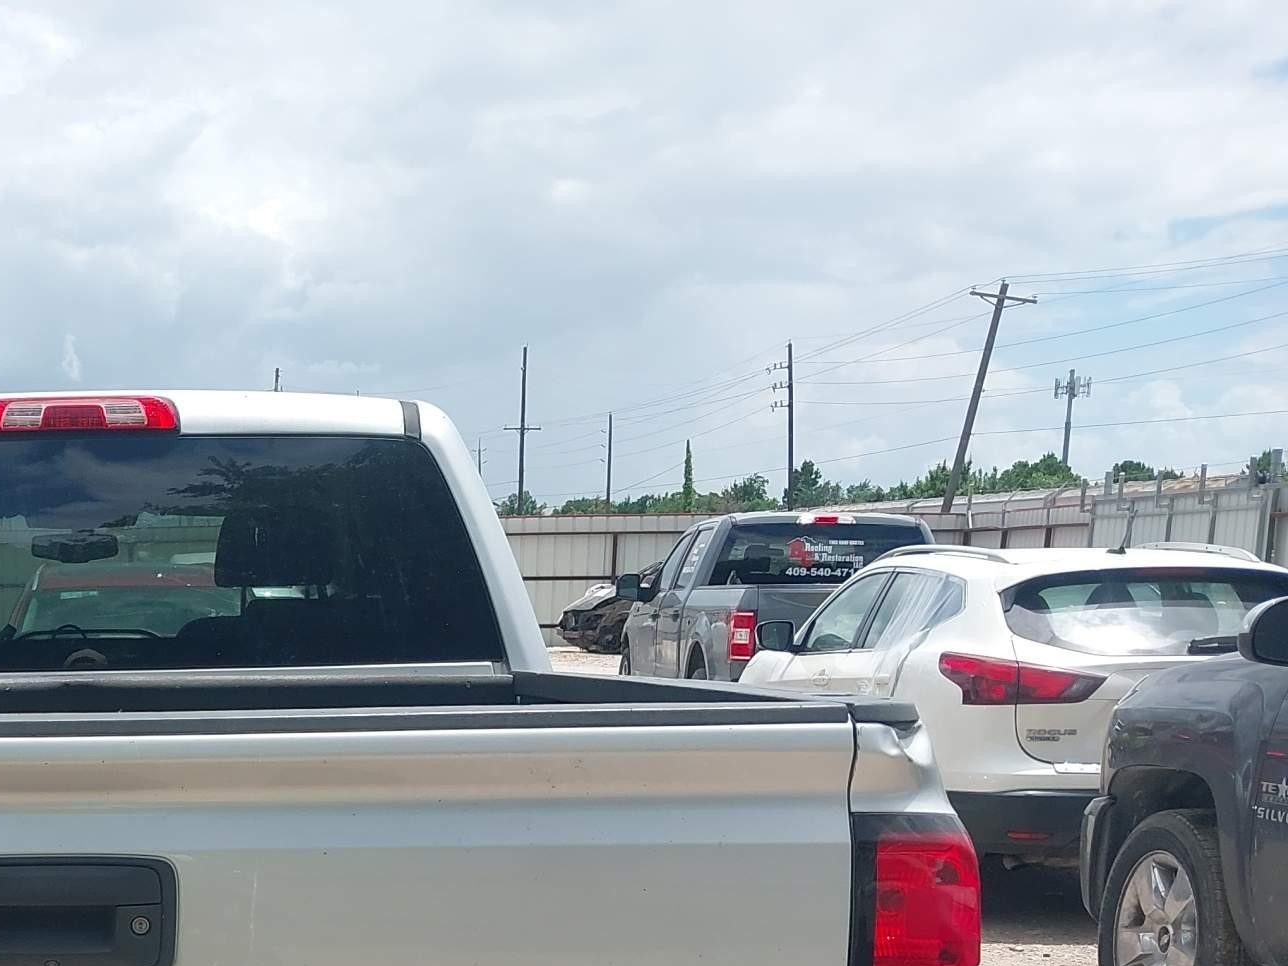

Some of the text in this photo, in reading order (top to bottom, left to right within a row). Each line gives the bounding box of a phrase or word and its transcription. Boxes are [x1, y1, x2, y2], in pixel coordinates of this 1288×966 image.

[805, 543, 833, 553] Roofing
[822, 553, 864, 562] Restoration
[785, 567, 855, 577] 409-540-471
